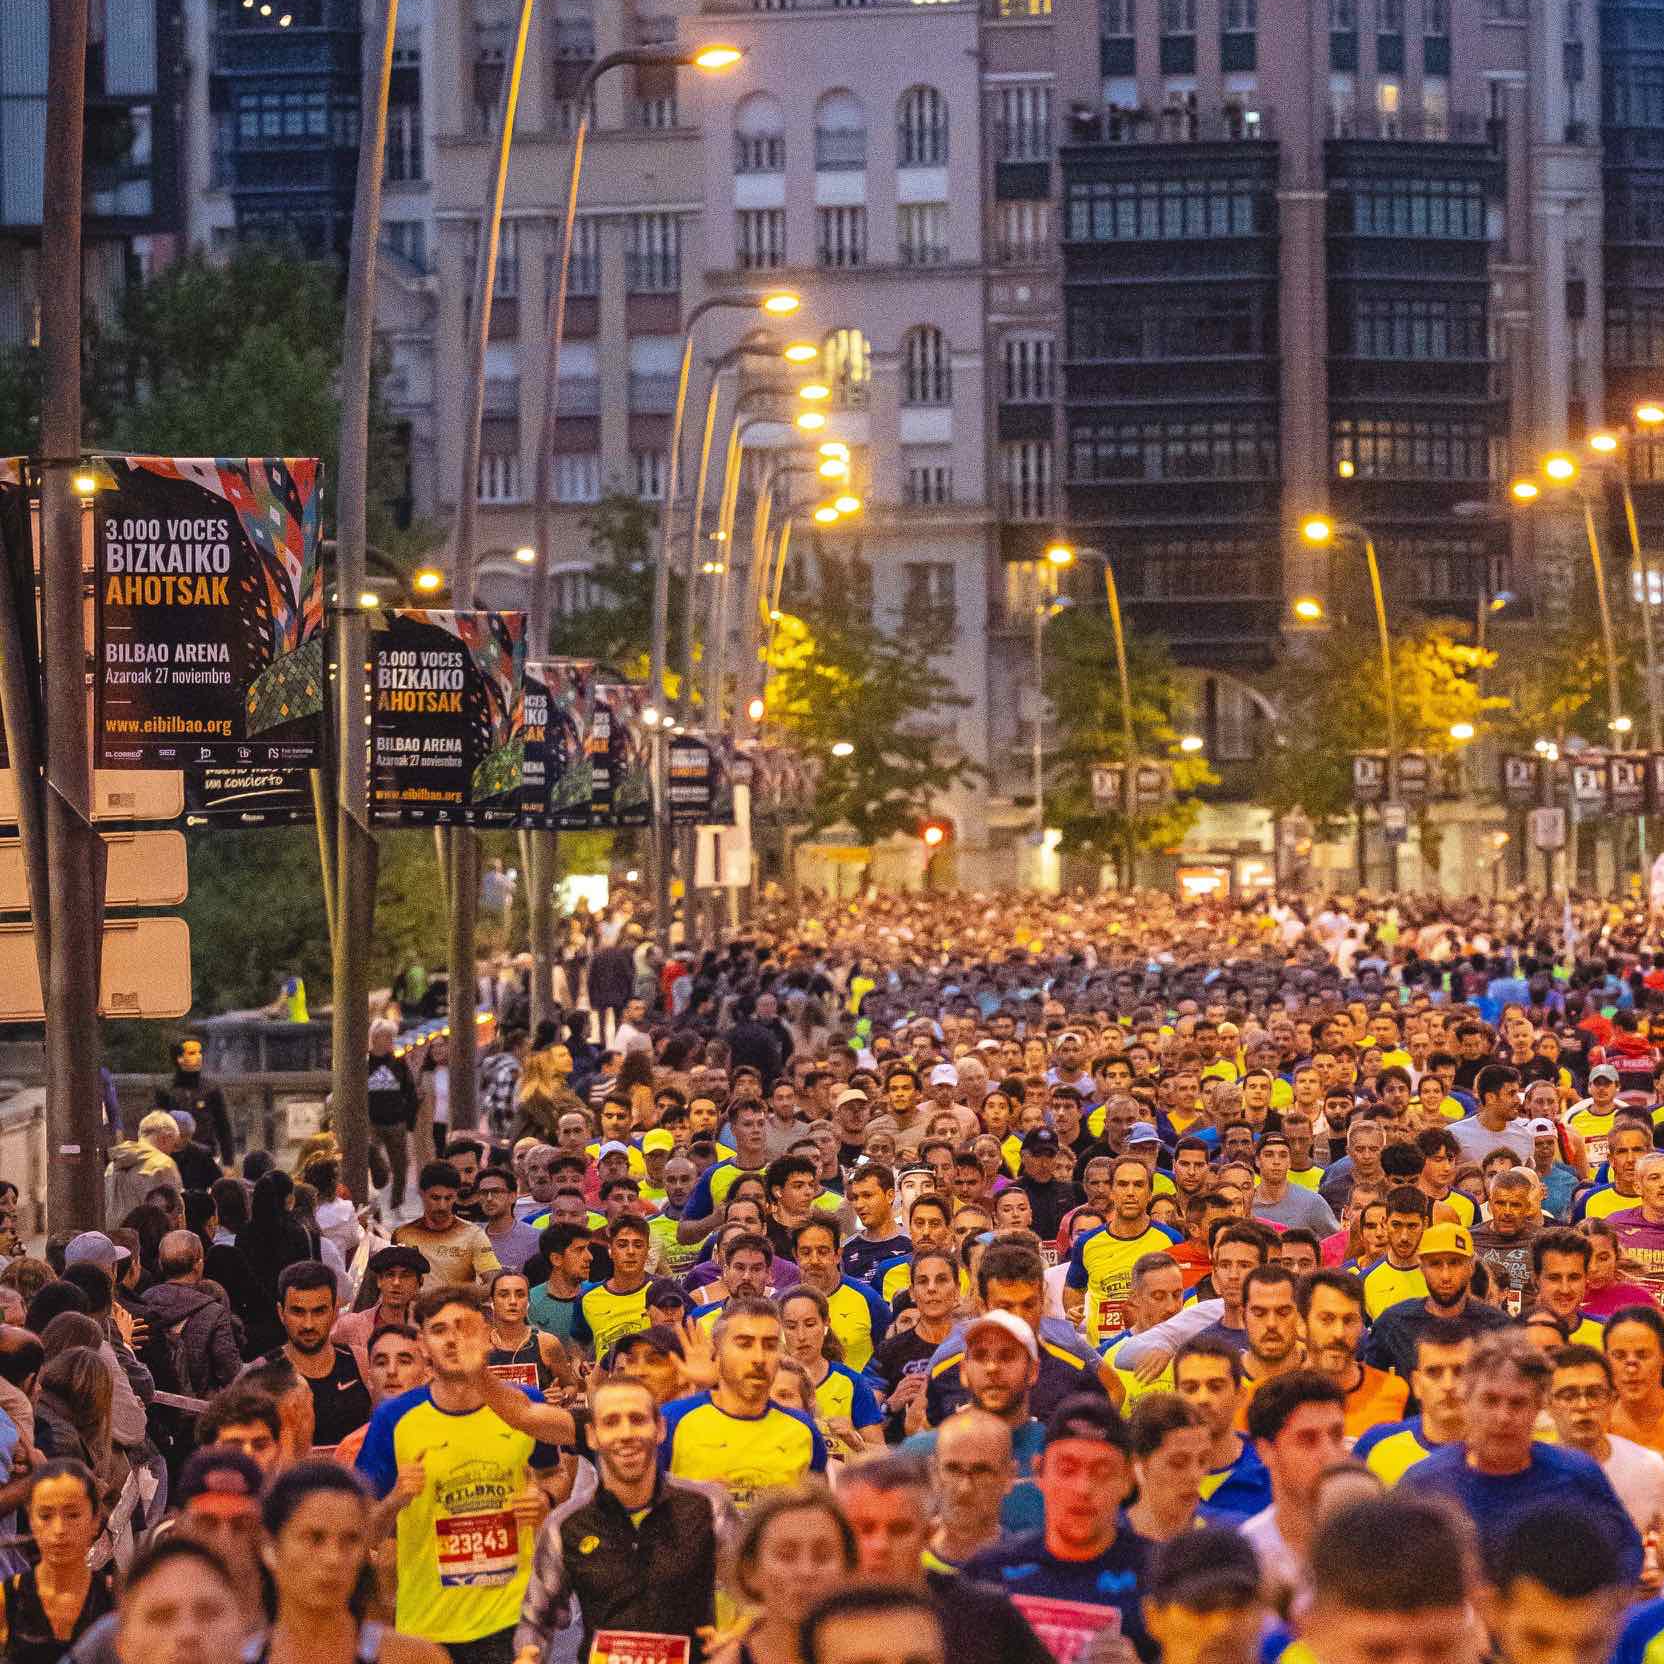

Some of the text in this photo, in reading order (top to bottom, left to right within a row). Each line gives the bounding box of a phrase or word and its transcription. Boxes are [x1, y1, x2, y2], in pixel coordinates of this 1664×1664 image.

[105, 519, 230, 541] 3.000 VOCES
[105, 543, 231, 573] BIZKAIKO
[105, 575, 231, 606] AHOTSAK
[105, 643, 231, 663] BILBAO ARENA
[377, 651, 464, 667] 3.000 VOCES
[105, 667, 232, 684] Azaroak 27 noviembre
[377, 668, 464, 690] BIZKAIKO
[377, 691, 464, 713] AHOTSAK
[105, 716, 233, 736] www.eibilbao.org
[376, 737, 463, 753] BILBAO ARENA
[204, 775, 283, 790] un concierto
[447, 1528, 509, 1555] 23243
